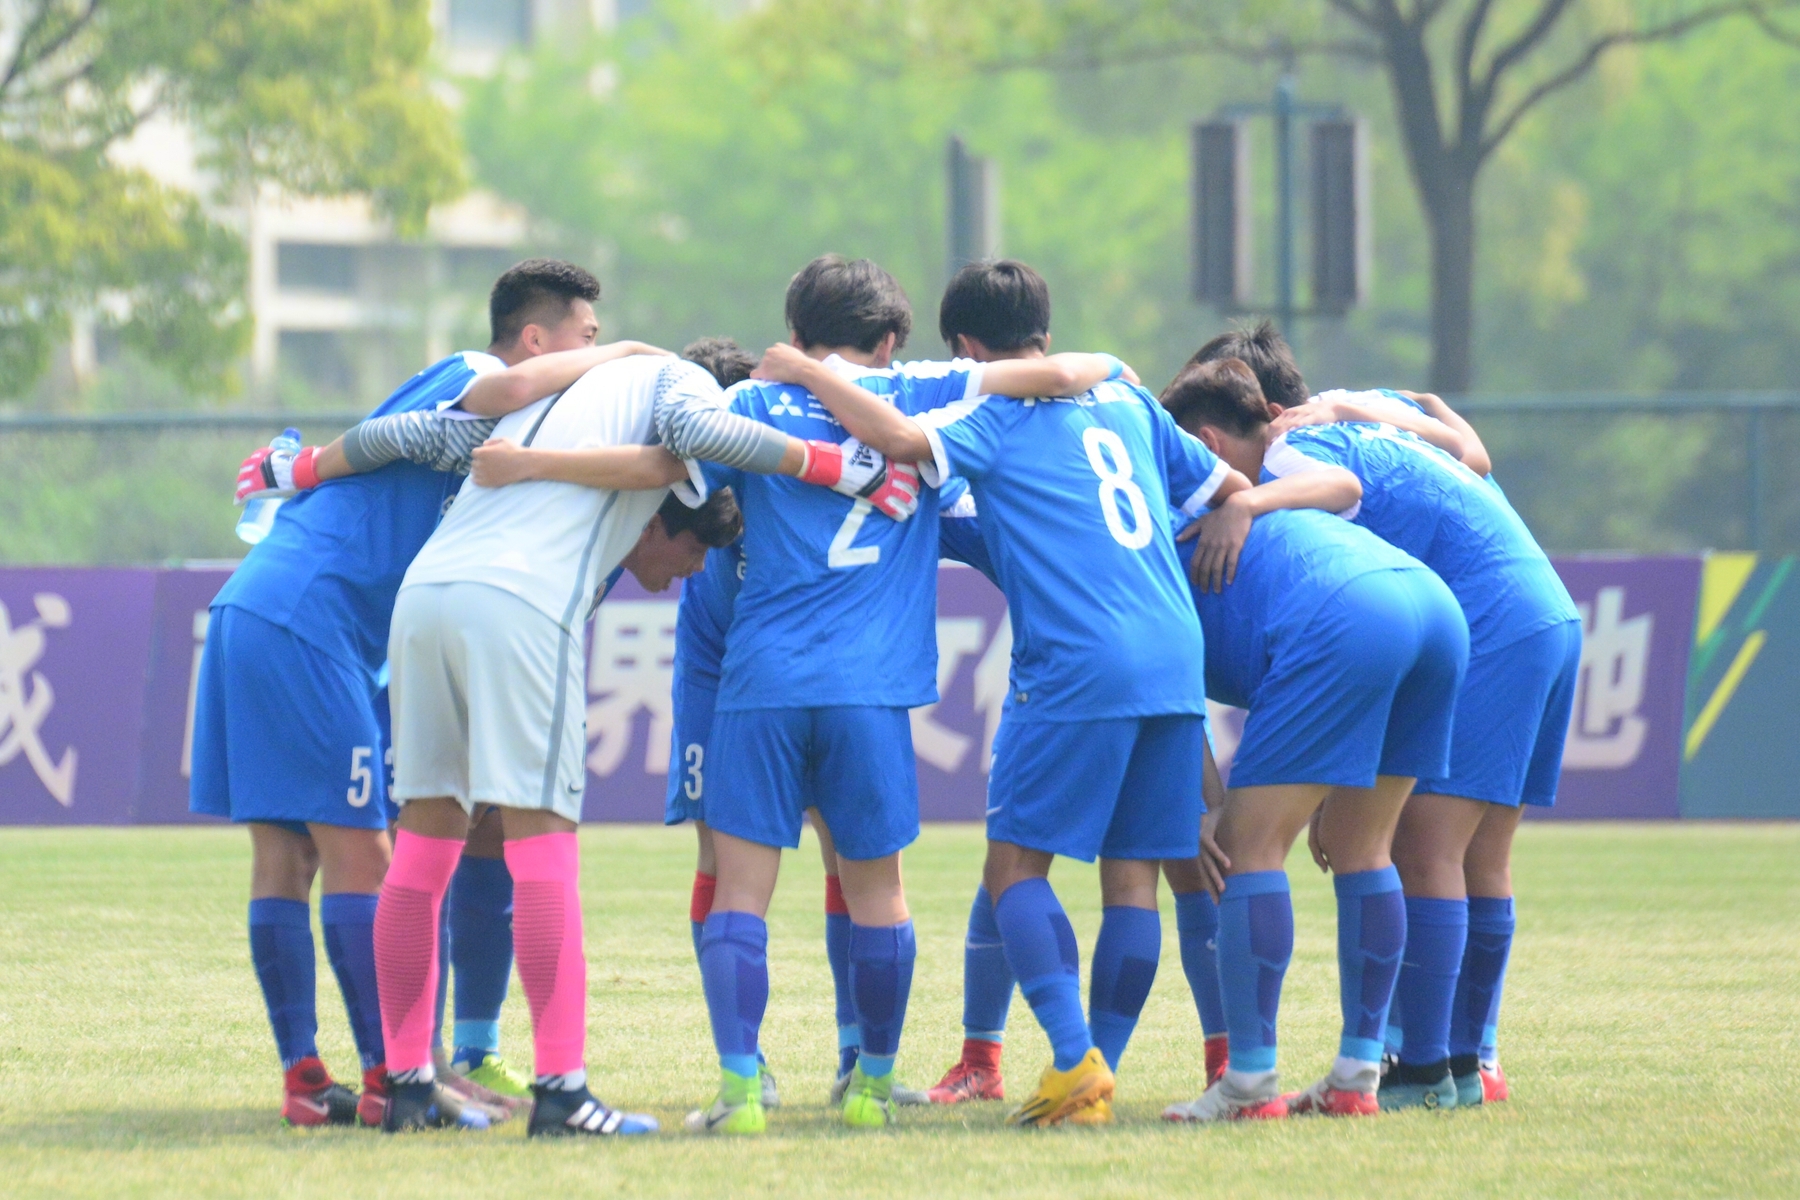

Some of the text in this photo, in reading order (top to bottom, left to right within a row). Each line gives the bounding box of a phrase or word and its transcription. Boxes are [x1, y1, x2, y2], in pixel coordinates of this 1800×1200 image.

[1082, 427, 1153, 550] 8
[828, 499, 879, 567] 2
[347, 747, 372, 808] 5
[684, 743, 704, 800] 3
